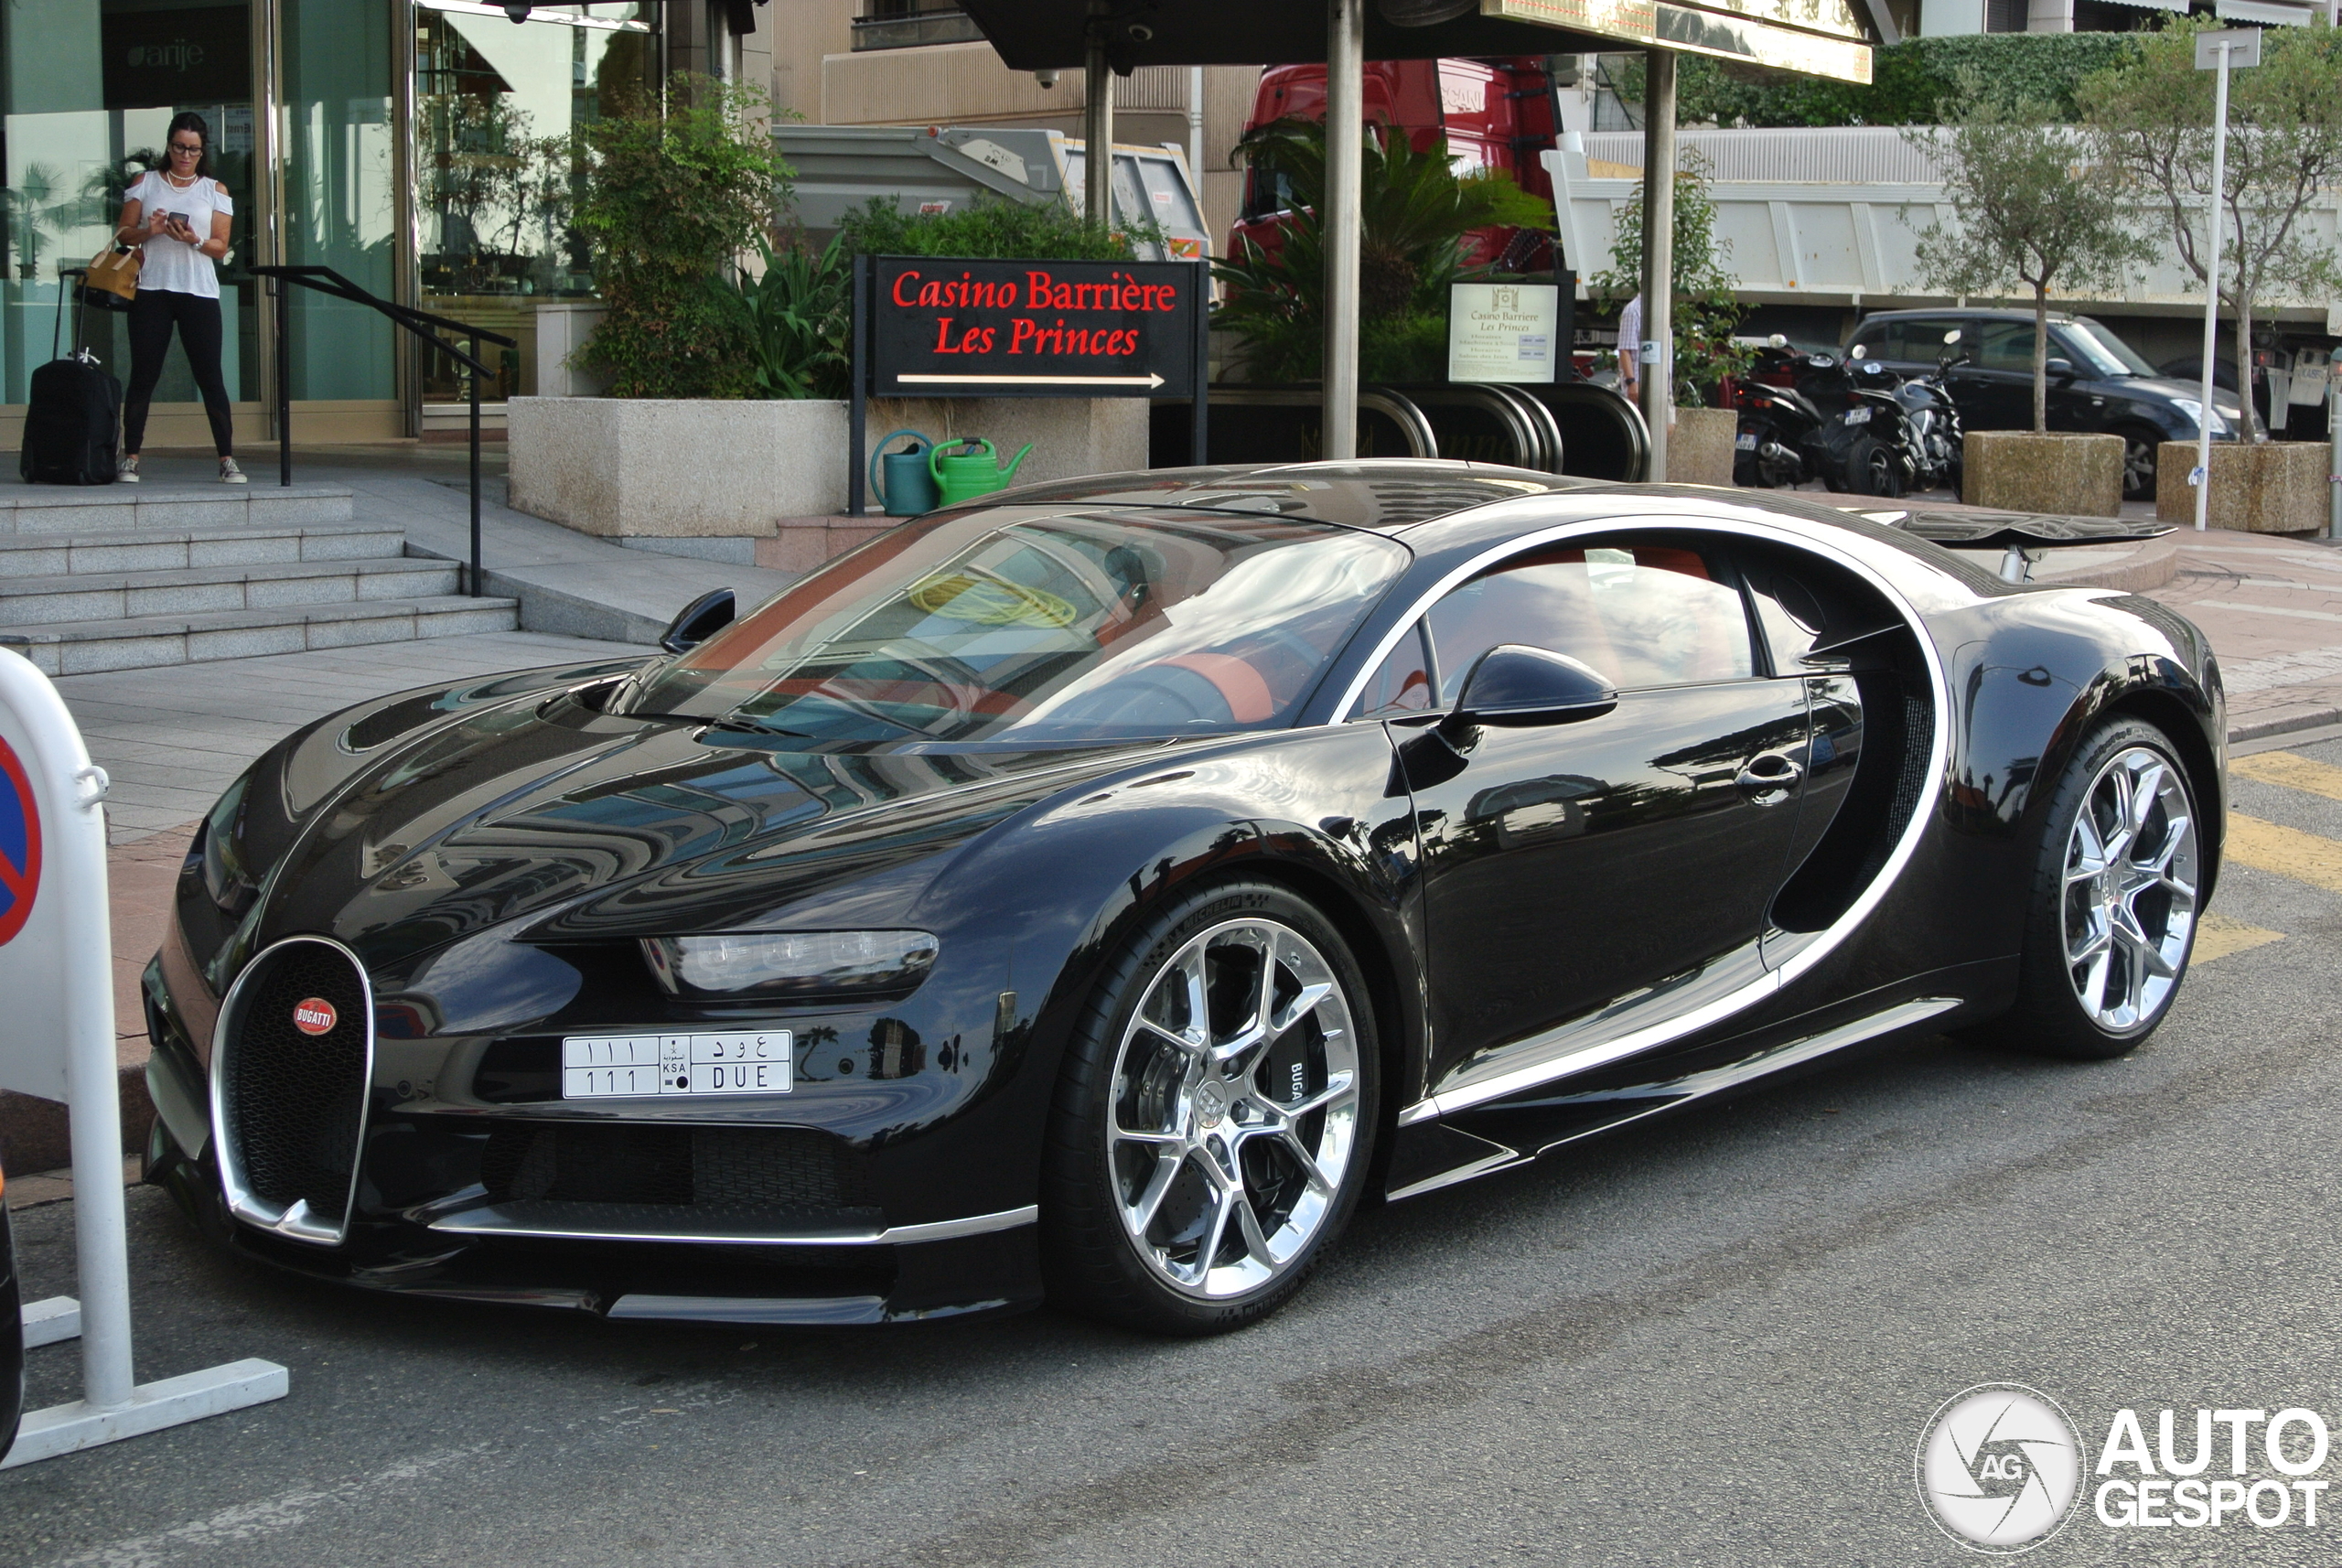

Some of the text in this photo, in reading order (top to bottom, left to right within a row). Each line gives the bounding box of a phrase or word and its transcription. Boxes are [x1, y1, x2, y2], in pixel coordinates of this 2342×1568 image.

[146, 38, 203, 72] arije
[893, 271, 1176, 311] Casino Barrière
[1471, 311, 1500, 320] Casino
[1480, 323, 1530, 331] Les Princes
[933, 317, 1138, 356] Les Princes
[1183, 896, 1241, 931] MICHELIN
[297, 1008, 330, 1026] BUGATTI
[586, 1065, 768, 1093] 111 DUE
[663, 1063, 686, 1073] KSA
